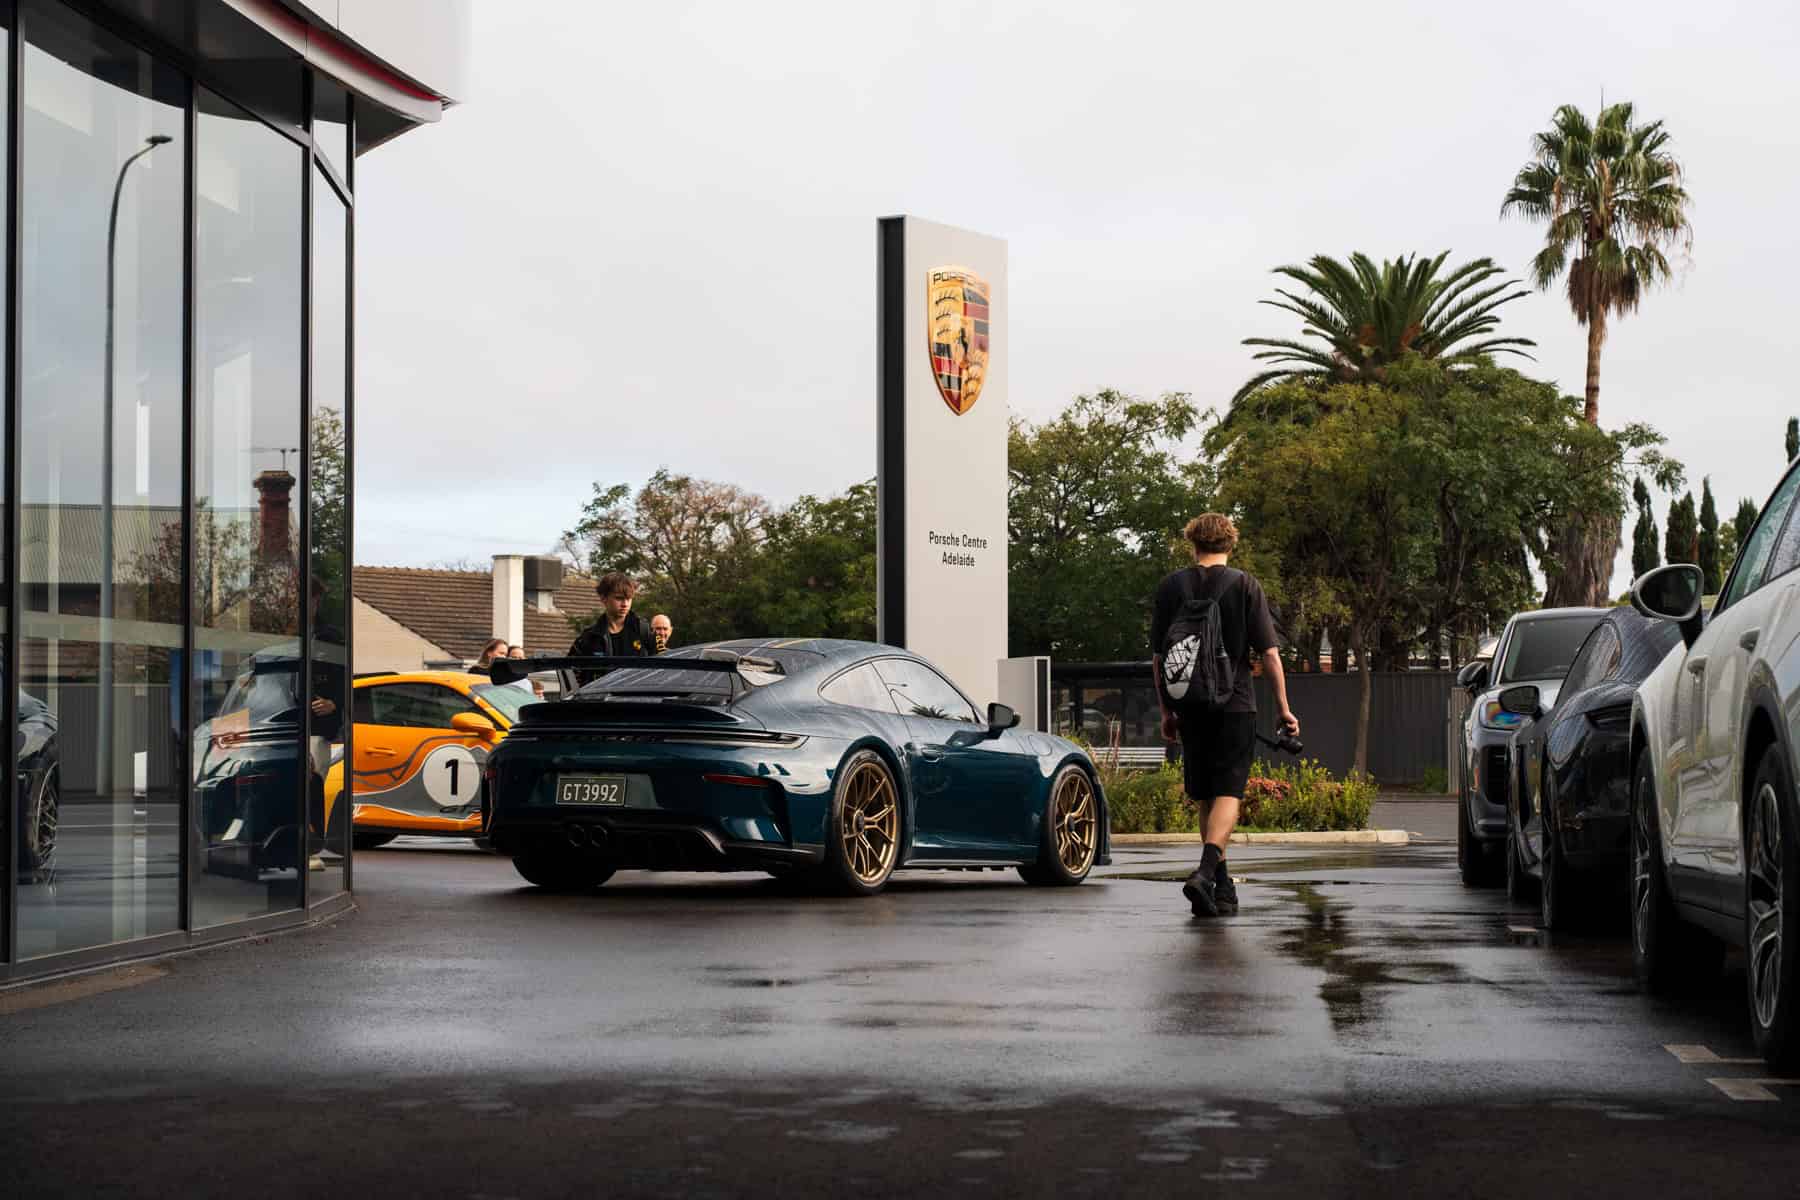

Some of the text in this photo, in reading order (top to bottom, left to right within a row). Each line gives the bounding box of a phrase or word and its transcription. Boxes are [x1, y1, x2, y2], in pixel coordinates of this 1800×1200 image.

[929, 531, 988, 549] Porsche Centre
[942, 551, 975, 567] Adelaide
[445, 758, 459, 796] 1
[563, 783, 618, 802] GT3992
